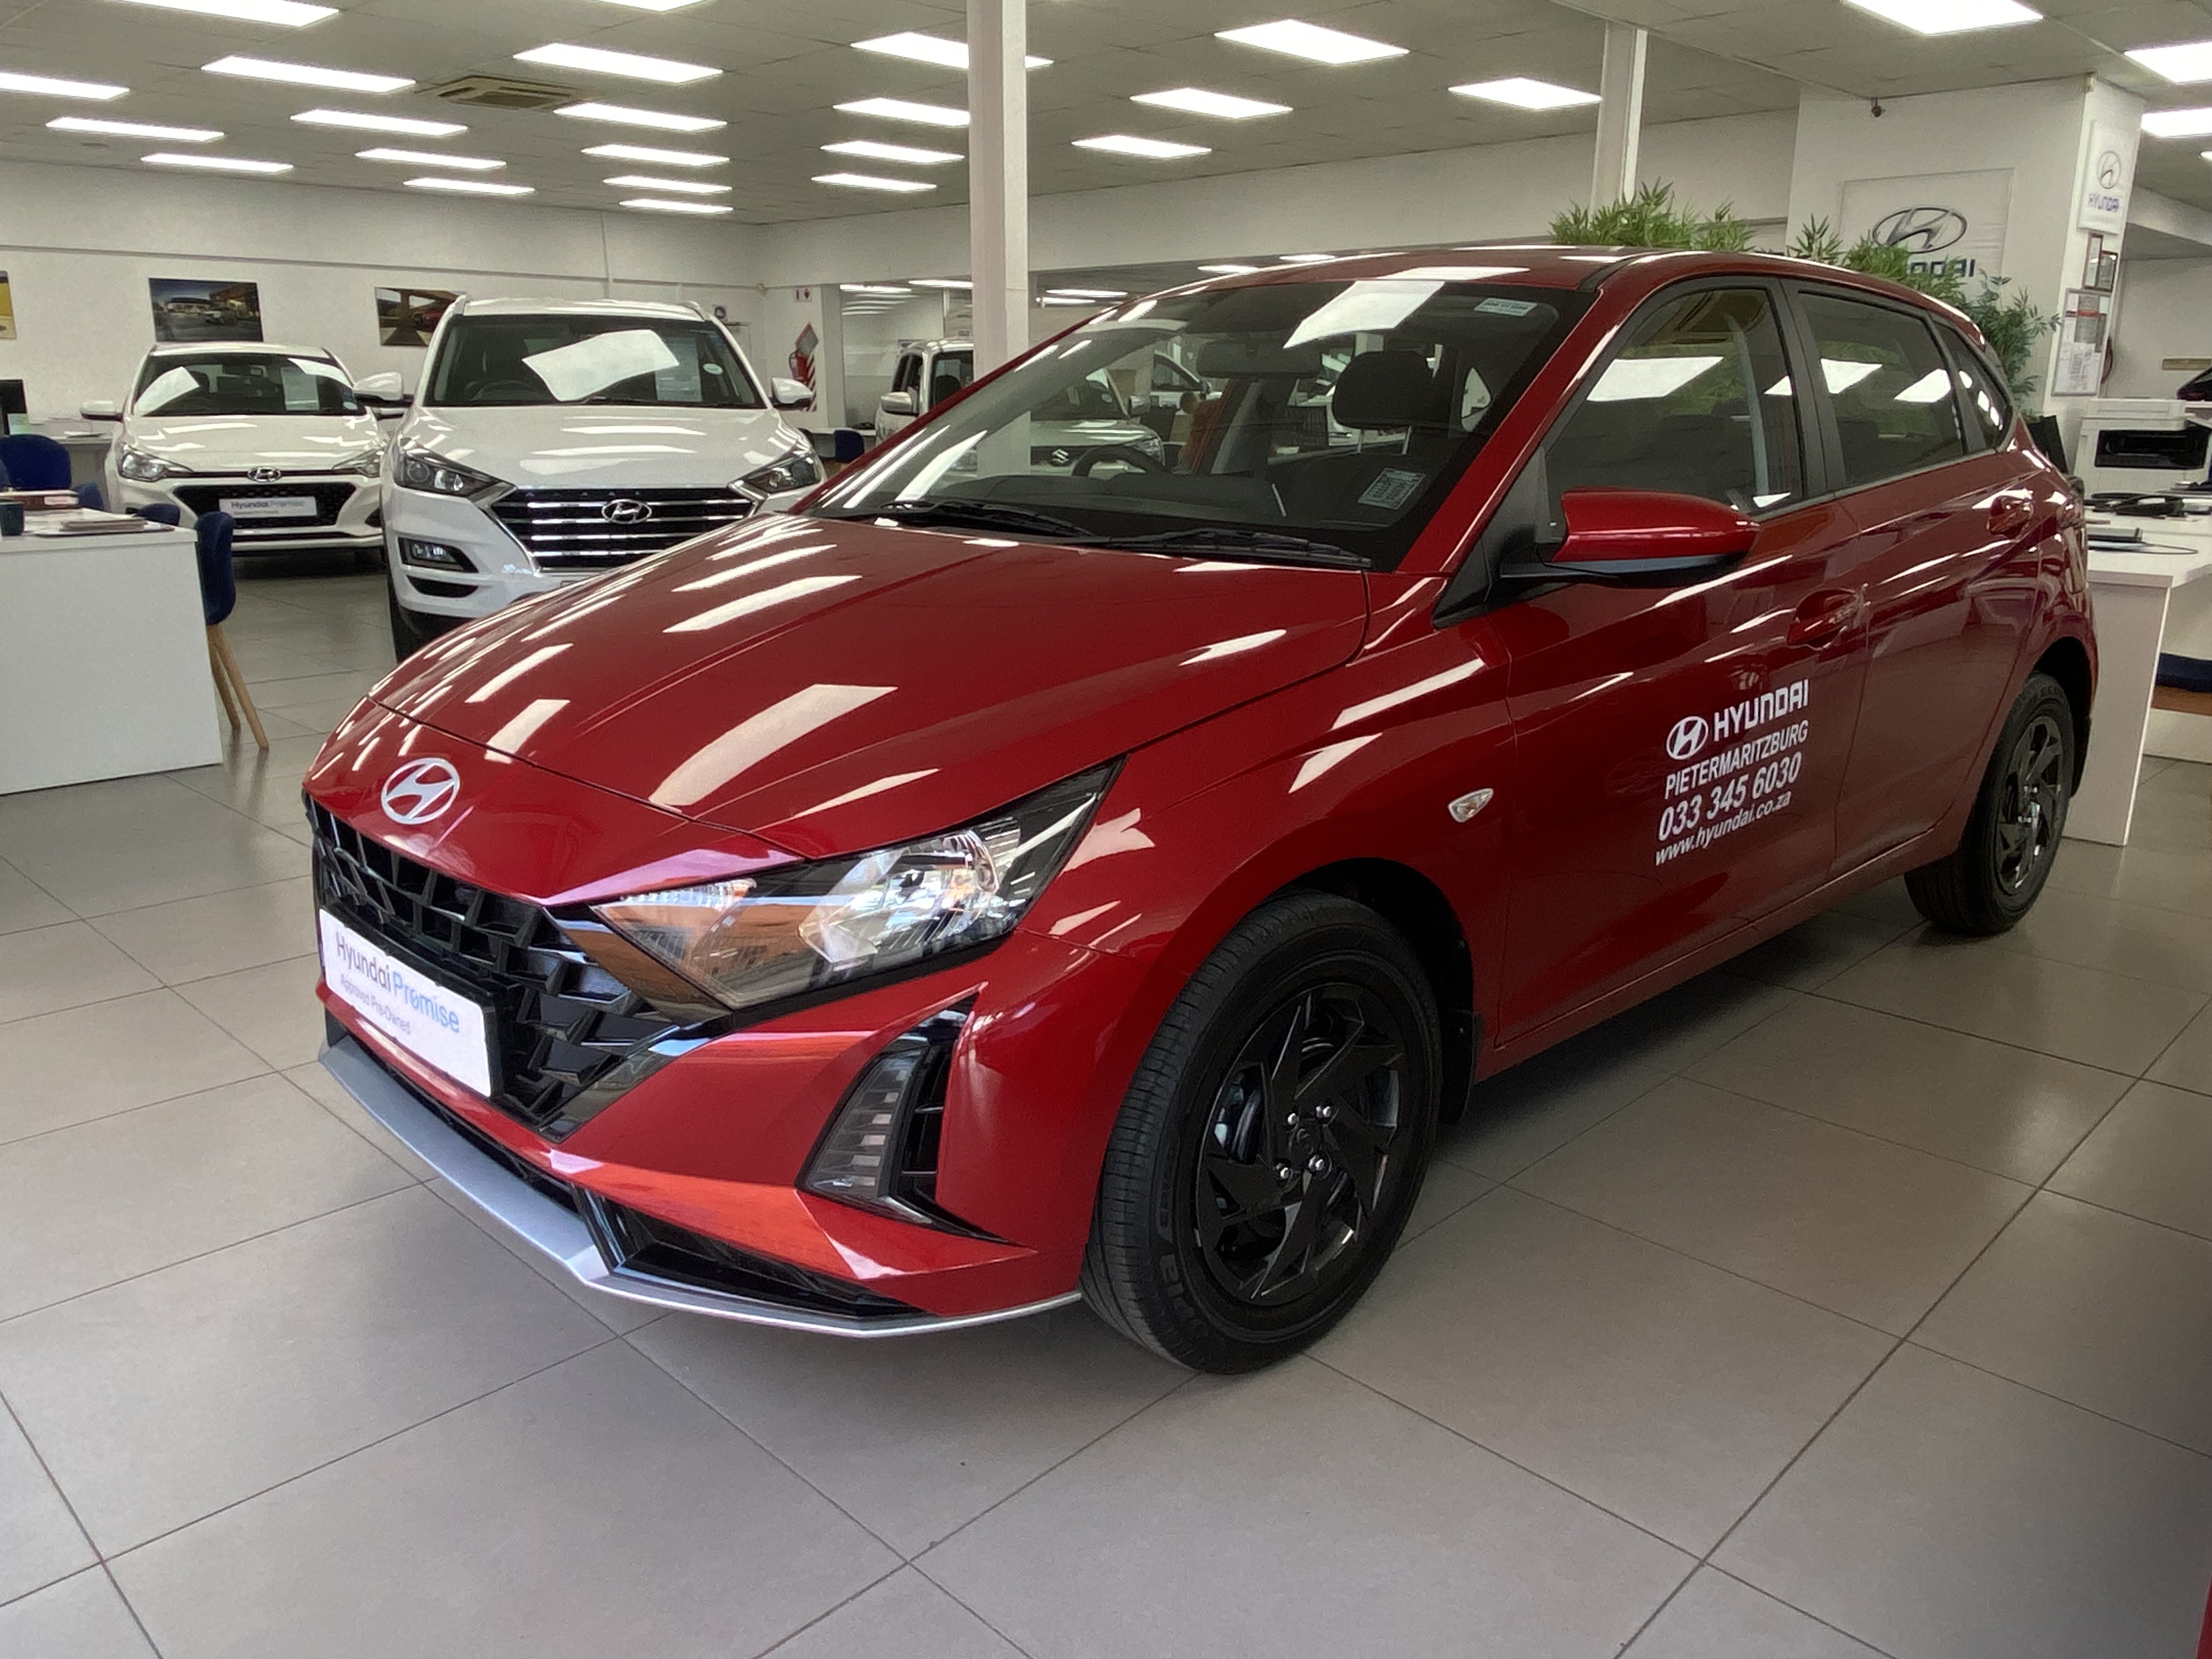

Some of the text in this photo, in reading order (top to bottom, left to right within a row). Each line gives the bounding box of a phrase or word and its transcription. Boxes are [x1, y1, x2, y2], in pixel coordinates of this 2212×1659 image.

[1713, 679, 1809, 742] HYUNDAI
[1658, 752, 1802, 841] 033 345 6030
[1664, 720, 1809, 799] PIETERMARITZBURG
[1655, 791, 1792, 866] www.hyundai.co.za
[335, 931, 460, 1034] Hyundai Promise
